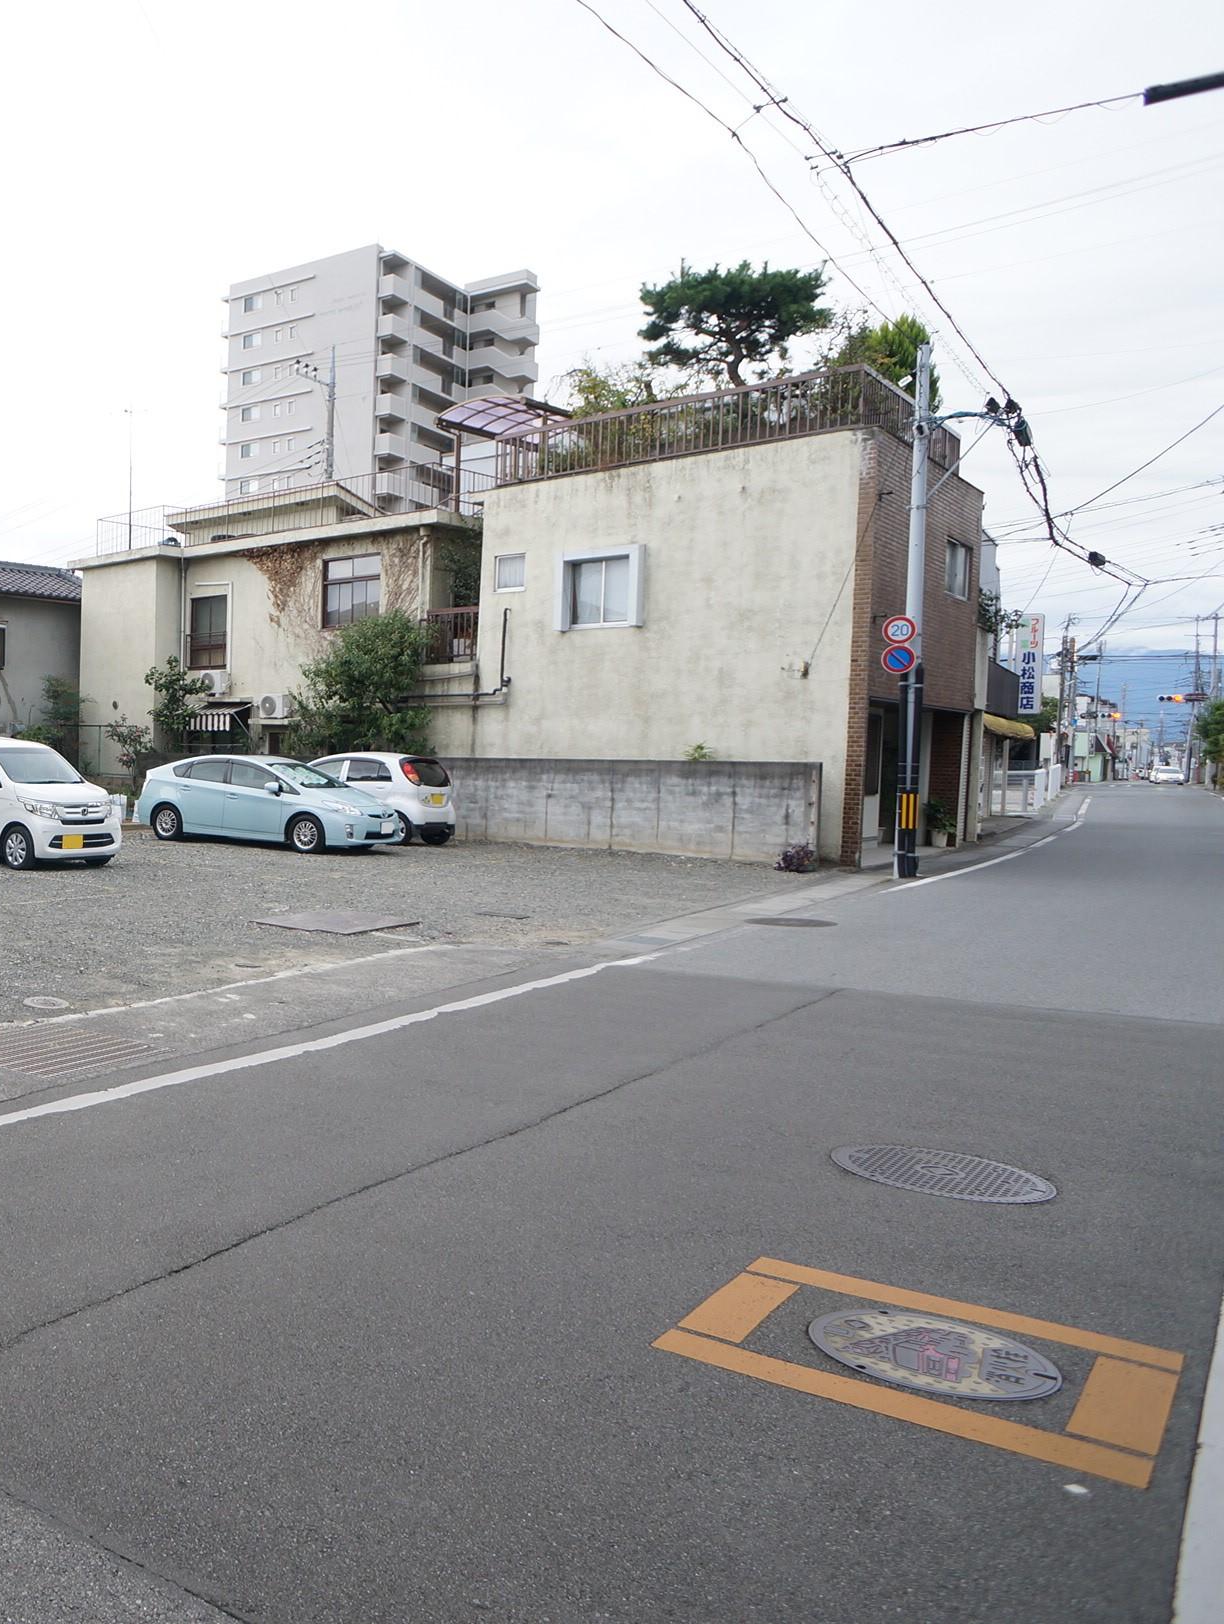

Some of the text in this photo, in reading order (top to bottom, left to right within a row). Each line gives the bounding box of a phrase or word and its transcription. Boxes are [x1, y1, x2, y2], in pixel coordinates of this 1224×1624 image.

[890, 623, 910, 637] 20
[1030, 618, 1039, 649] フルーツ
[1019, 651, 1036, 709] 小松商店
